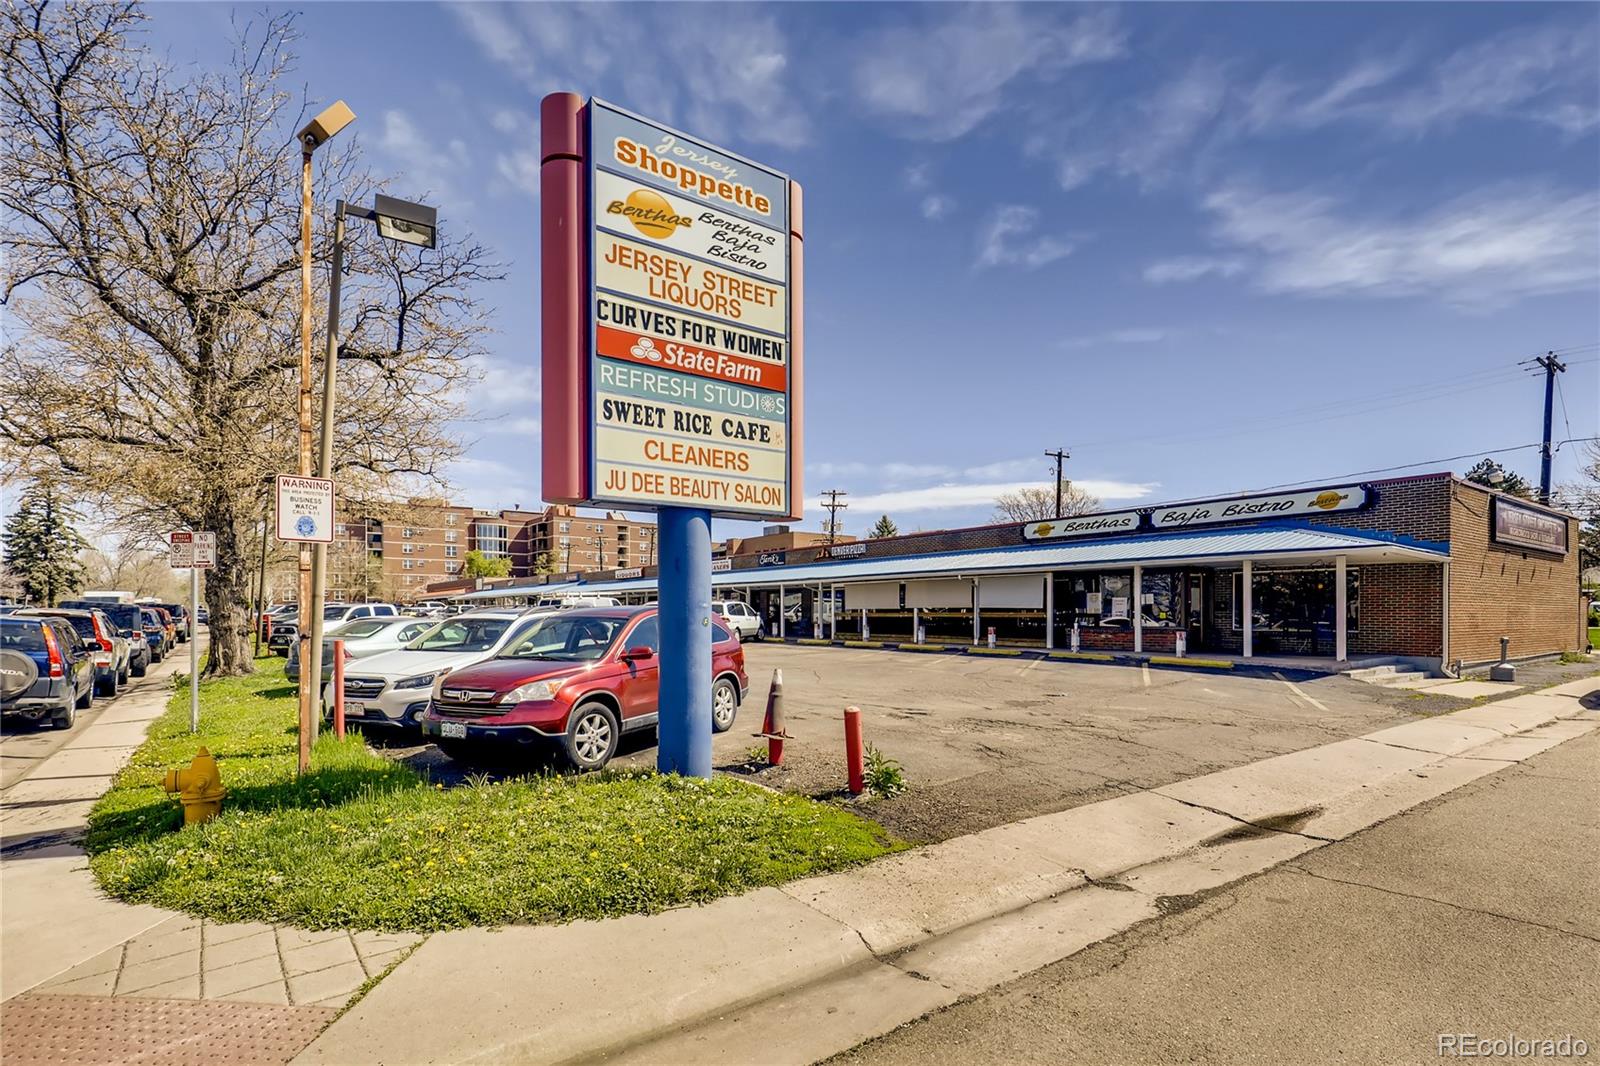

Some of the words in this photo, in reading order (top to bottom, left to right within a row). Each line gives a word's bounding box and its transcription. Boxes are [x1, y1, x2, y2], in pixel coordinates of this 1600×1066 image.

[655, 134, 738, 178] Jersey
[616, 137, 770, 215] Shoppette
[607, 200, 692, 229] Berthas
[698, 212, 776, 246] Berthas
[707, 245, 767, 271] Bistro
[711, 230, 762, 254] Baja
[604, 243, 692, 284] JERSEY
[702, 270, 778, 308] STREET
[649, 277, 742, 319] LIQUORS
[597, 299, 676, 337] CURVES
[682, 320, 716, 346] FOR
[722, 329, 782, 361] WOMEN
[600, 363, 697, 399] REFRESH
[603, 398, 666, 429] SWEET
[674, 410, 713, 436] RICE
[721, 418, 771, 444] CAFE
[643, 440, 750, 472] CLEANERS
[282, 478, 330, 491] WARNING
[289, 496, 322, 504] BUSINESS
[604, 469, 626, 491] JU
[632, 472, 664, 495] DEE
[670, 476, 730, 502] BEAUTY
[734, 483, 781, 506] SALON
[1064, 518, 1132, 533] Berthas
[1161, 508, 1212, 526] Baja
[1221, 499, 1295, 517] Bistro
[198, 534, 208, 542] NO
